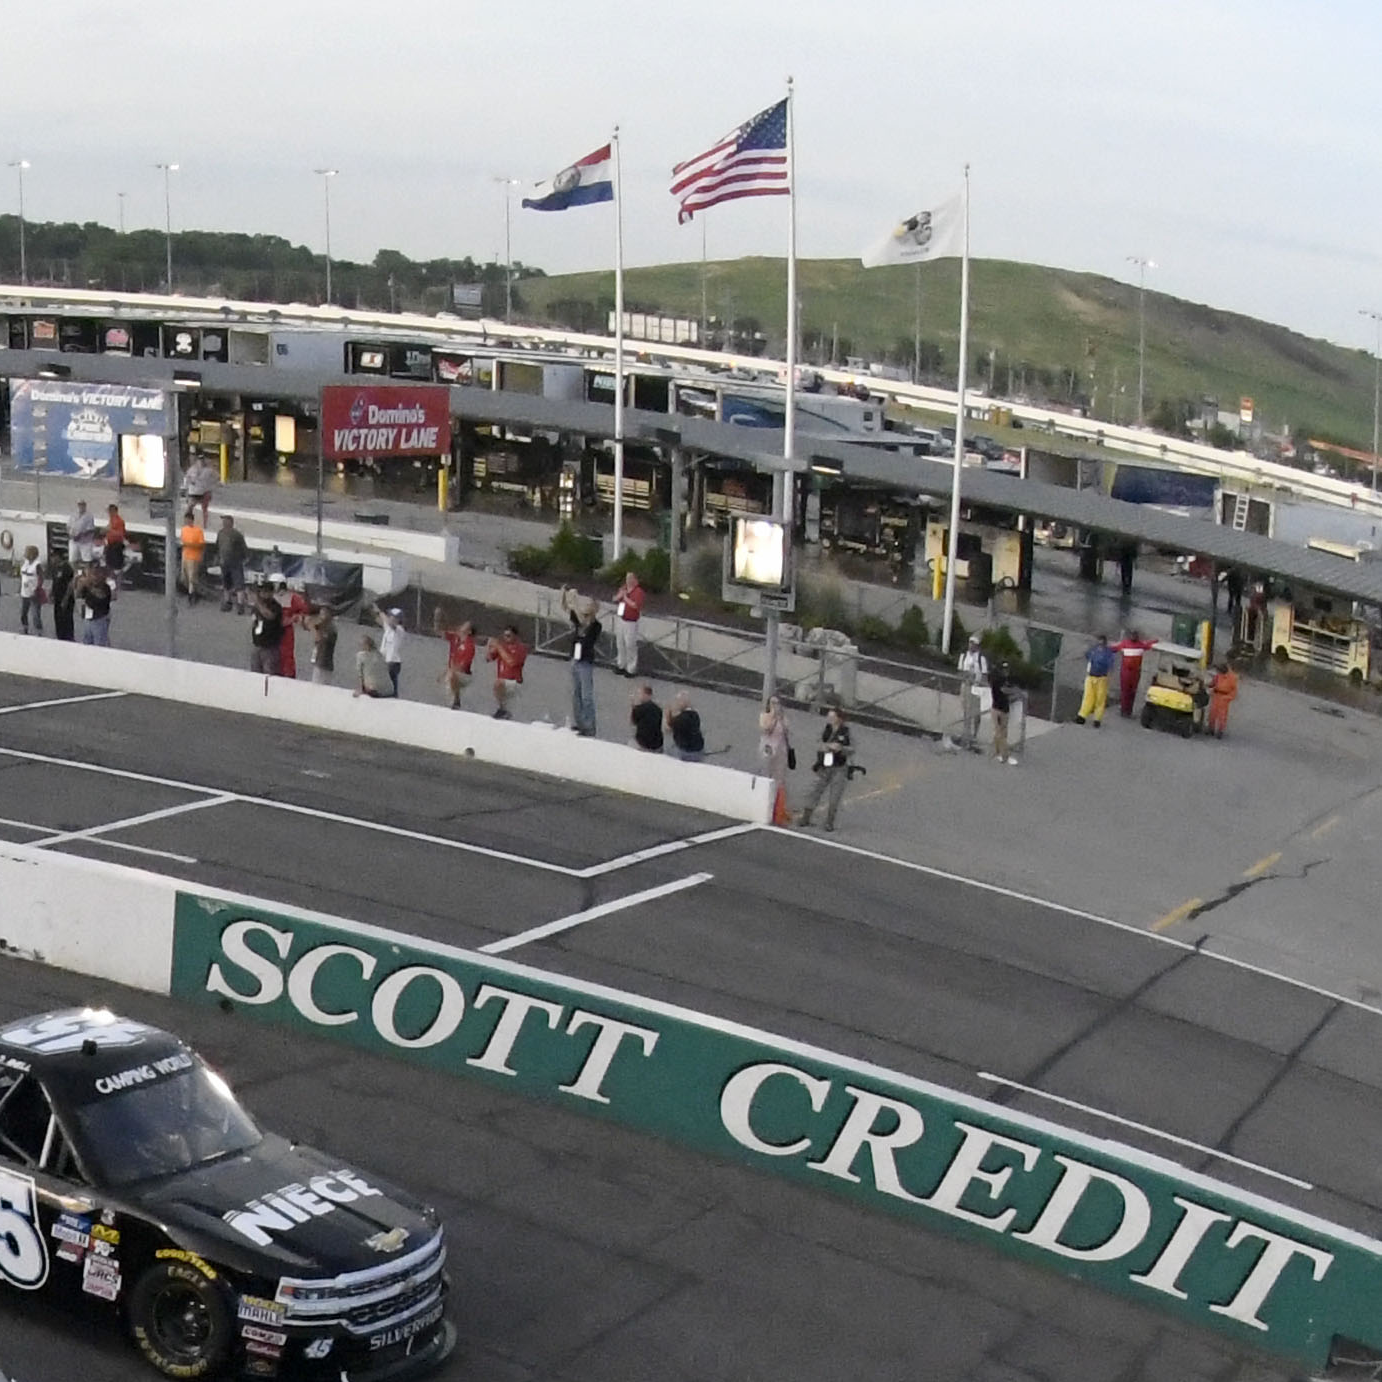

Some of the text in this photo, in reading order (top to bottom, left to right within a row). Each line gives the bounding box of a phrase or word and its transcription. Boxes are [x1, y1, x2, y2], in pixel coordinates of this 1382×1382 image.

[82, 392, 128, 408] VICTORY
[131, 395, 163, 411] LANE
[368, 403, 425, 425] Domino's
[334, 427, 438, 452] VICTORY LANE
[95, 1053, 192, 1094] CAMPING WORLD
[205, 918, 1337, 1334] SCOTT CREDIT
[227, 1168, 384, 1246] NIECE
[304, 1338, 334, 1359] 45
